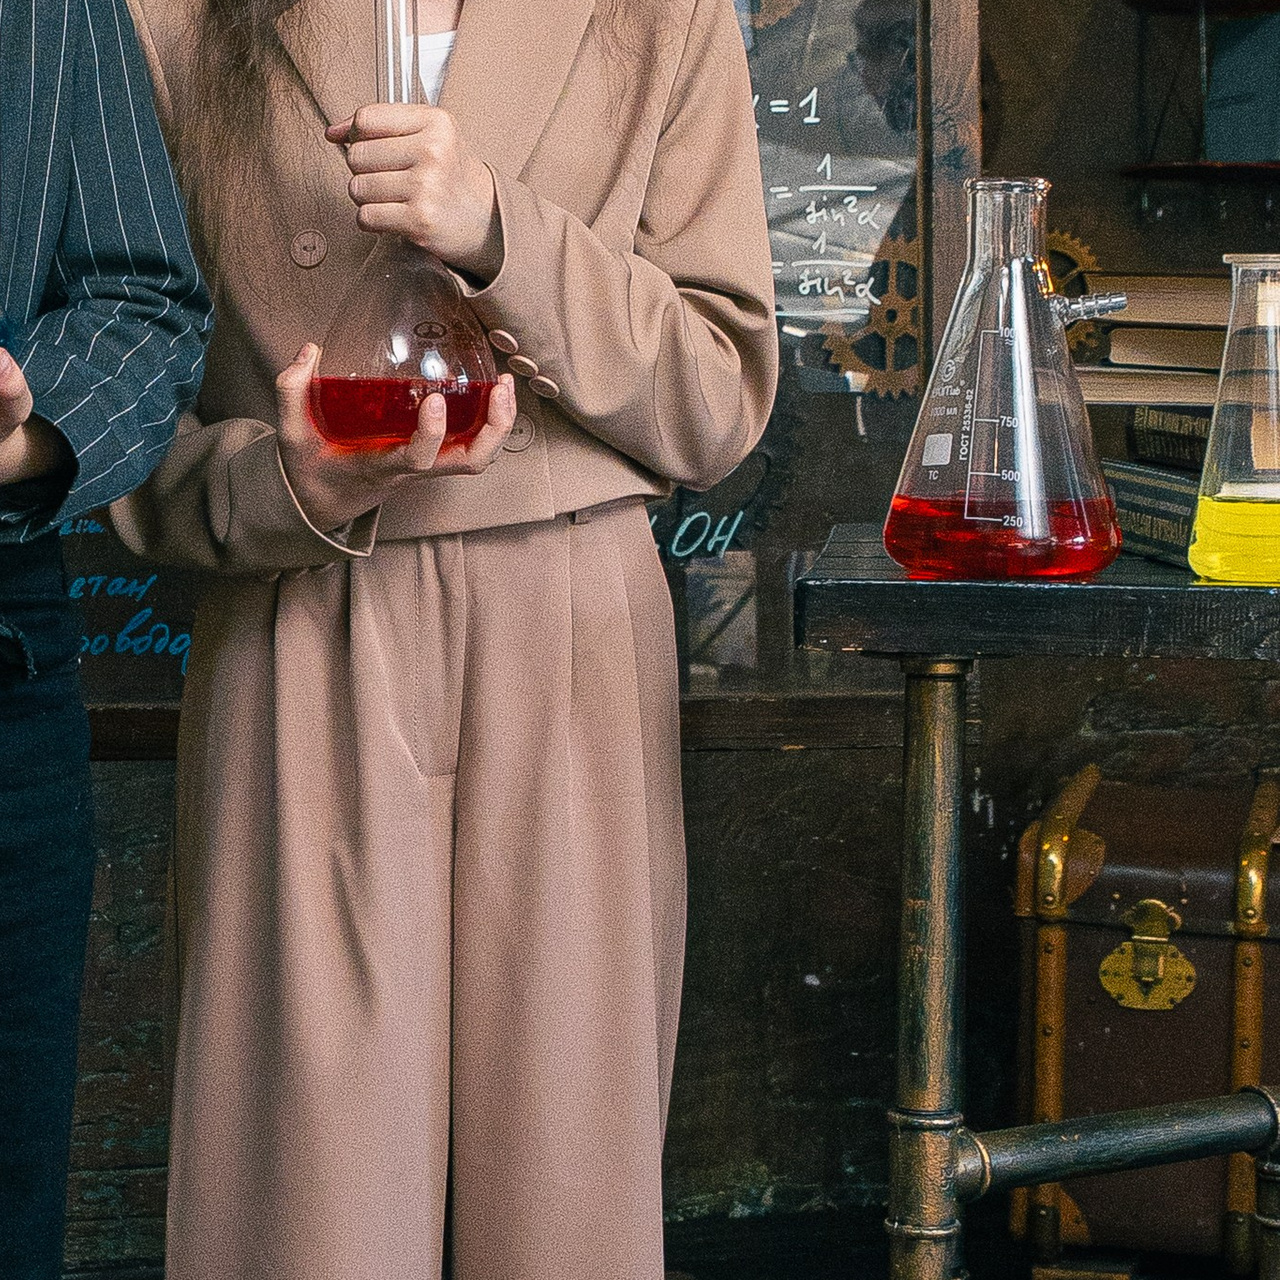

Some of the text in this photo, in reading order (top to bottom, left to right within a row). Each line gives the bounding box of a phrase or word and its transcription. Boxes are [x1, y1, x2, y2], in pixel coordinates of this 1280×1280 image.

[1000, 416, 1019, 429] 750
[958, 434, 969, 461] ГОСТ
[1001, 470, 1021, 482] 500
[1003, 515, 1024, 528] 250
